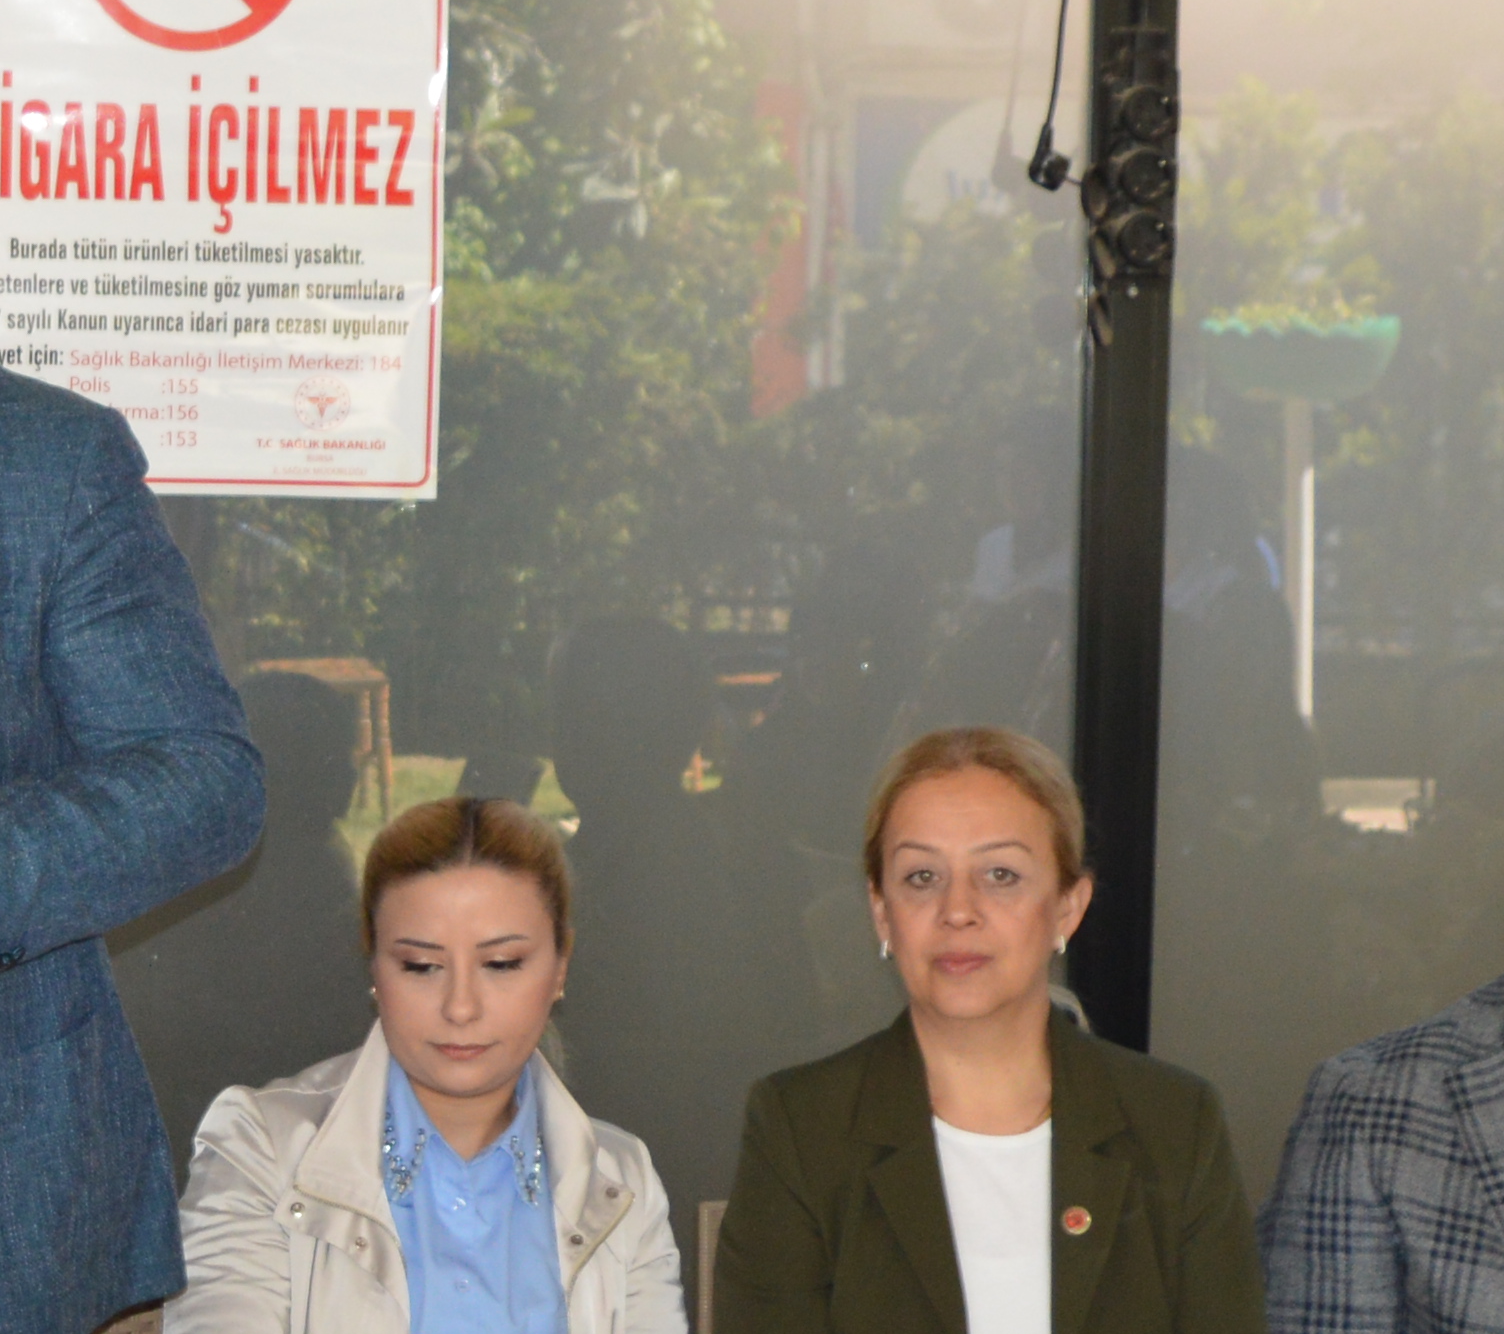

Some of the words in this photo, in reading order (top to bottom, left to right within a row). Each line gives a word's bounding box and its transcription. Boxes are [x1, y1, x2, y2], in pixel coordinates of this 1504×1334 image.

[187, 74, 416, 234] İÇİLMEZ
[9, 238, 67, 260] Burada
[73, 239, 117, 261] tütün
[123, 239, 189, 262] ürünleri
[195, 241, 288, 264] tüketilmesi
[294, 243, 365, 269] yasaktır.
[70, 278, 89, 295] ve
[94, 273, 208, 298] tüketilmesine
[214, 276, 241, 303] göz
[246, 282, 300, 303] yuman
[305, 278, 405, 301] sorumlulara
[7, 309, 52, 334] sayılı
[57, 309, 108, 330] Kanun
[113, 314, 184, 336] uyarınca
[190, 311, 228, 333] idari
[233, 317, 270, 337] para
[275, 316, 328, 335] cezası
[332, 314, 410, 340] uygulanır
[28, 343, 64, 372] için:
[70, 350, 124, 371] Sağlık
[129, 351, 212, 373] Bakanlığı
[217, 349, 283, 373] İletişim
[288, 353, 365, 372] Merkezi:
[370, 355, 402, 372] 184
[69, 375, 111, 393] Polis
